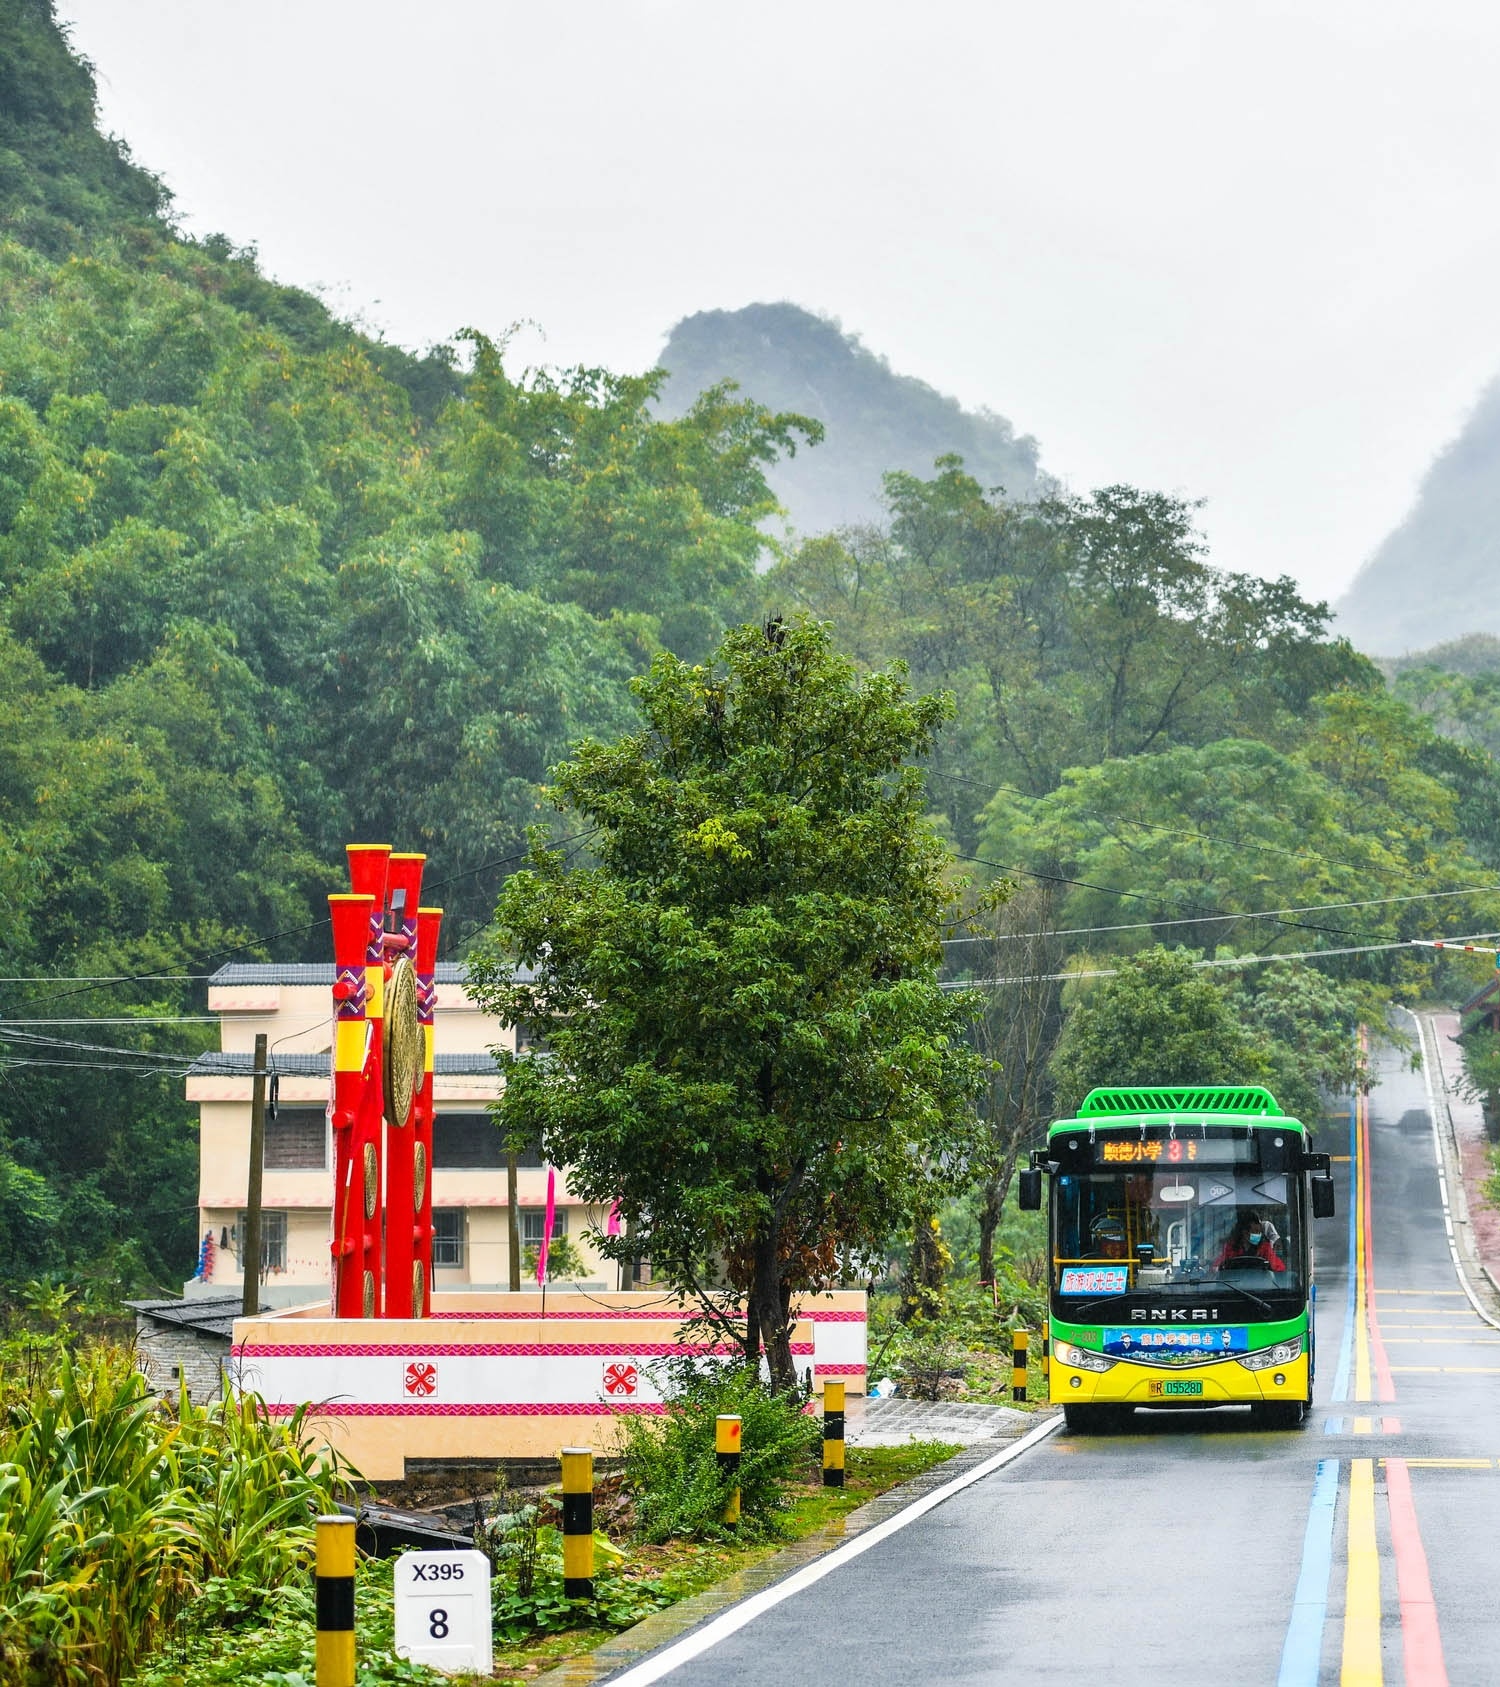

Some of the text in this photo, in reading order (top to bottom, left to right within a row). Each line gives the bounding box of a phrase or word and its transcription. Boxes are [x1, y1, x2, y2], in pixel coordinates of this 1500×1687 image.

[1064, 1271, 1125, 1291] 旅游观光巴士
[1131, 1309, 1218, 1320] ANKAI
[412, 1563, 465, 1582] X395
[429, 1608, 450, 1639] 8
